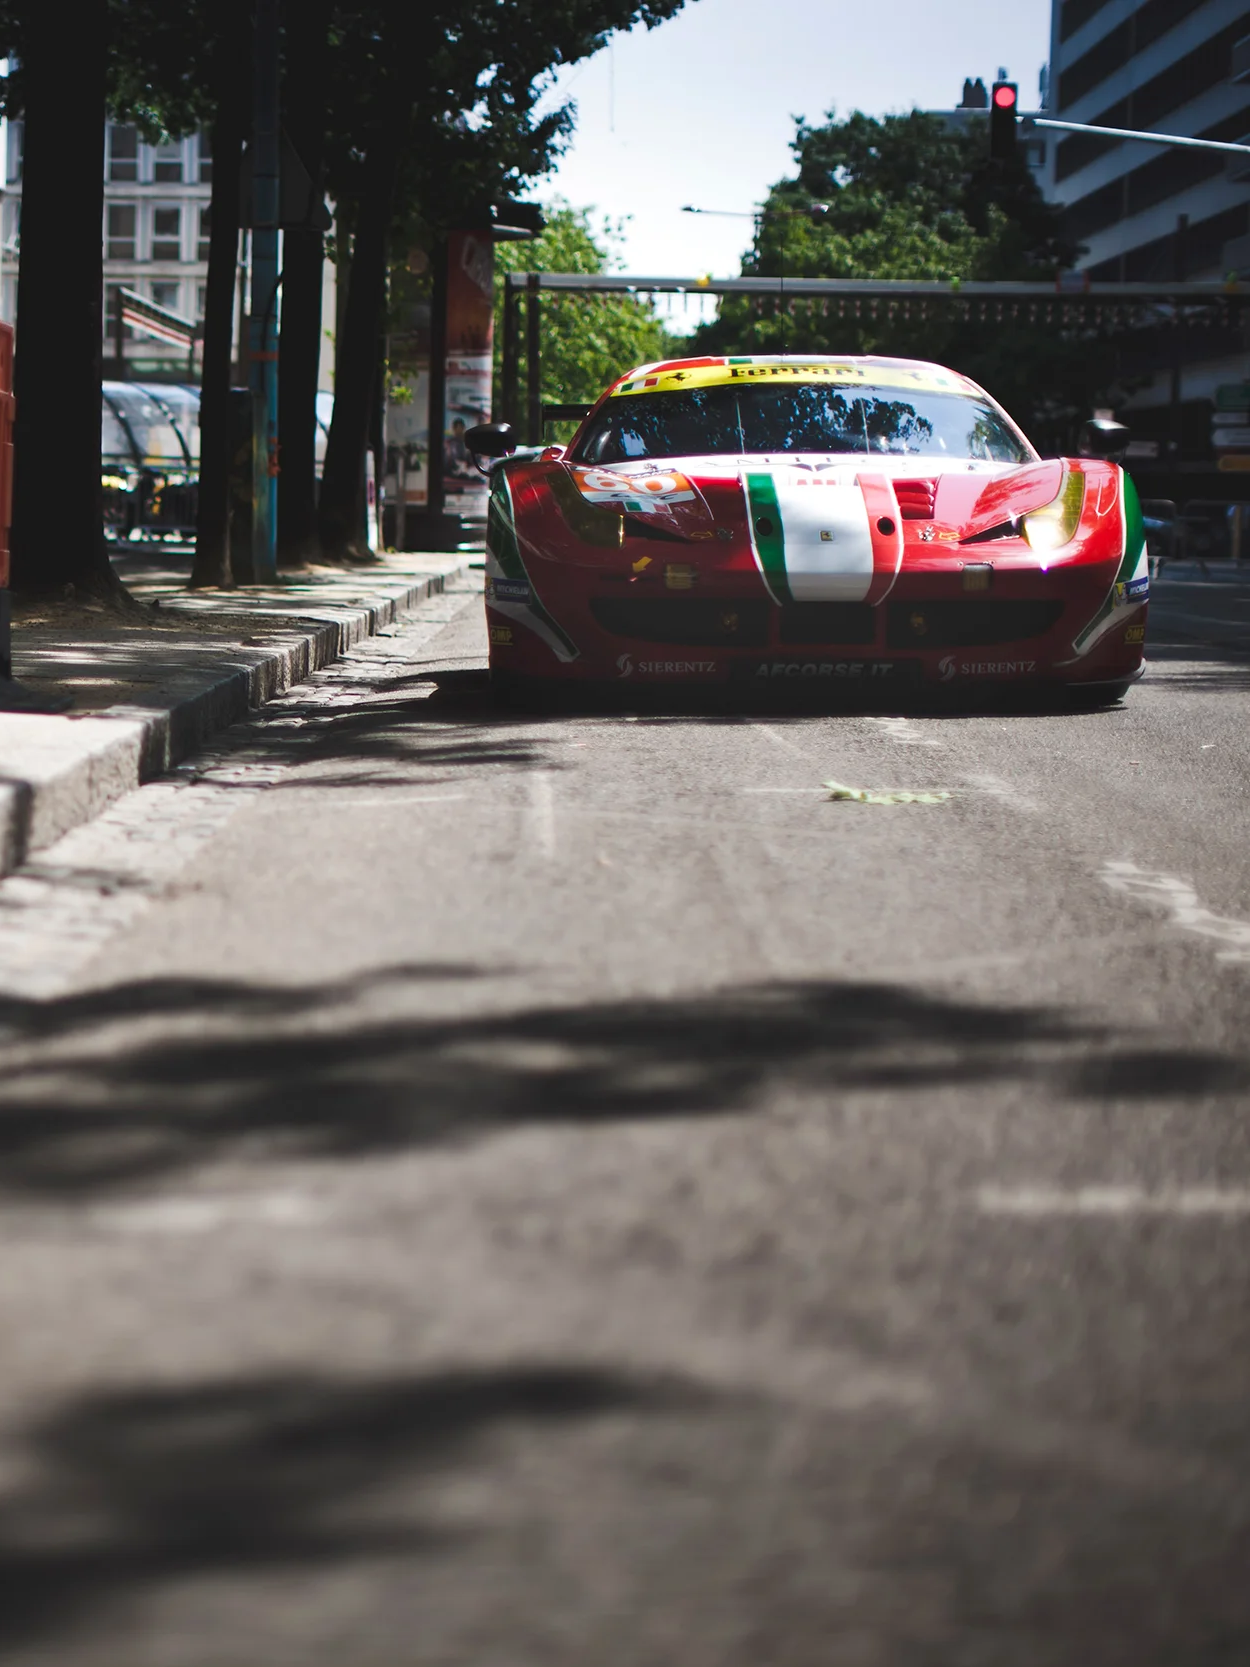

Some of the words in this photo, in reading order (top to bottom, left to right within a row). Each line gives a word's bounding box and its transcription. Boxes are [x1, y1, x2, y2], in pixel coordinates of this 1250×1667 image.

[729, 365, 866, 379] Ferrari
[583, 472, 678, 495] 60
[496, 583, 530, 596] MICHELIN
[490, 628, 513, 643] OMP
[1125, 627, 1145, 641] OMP
[638, 661, 717, 673] SIERENTZ
[961, 660, 1037, 674] SIERENTZ
